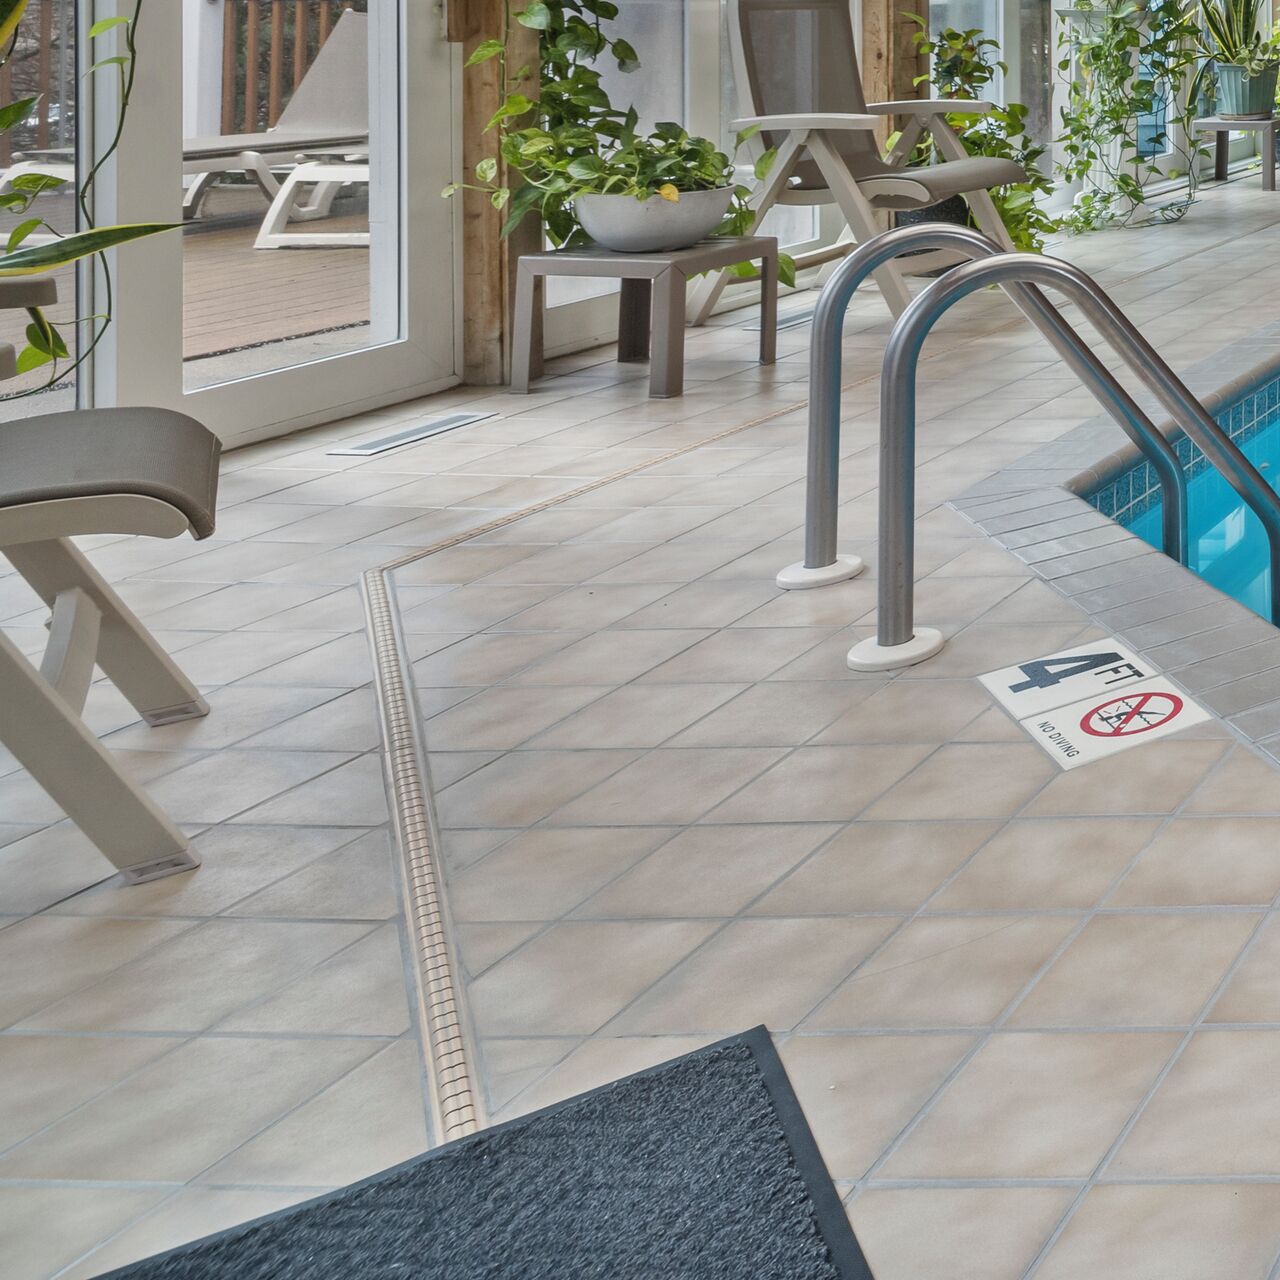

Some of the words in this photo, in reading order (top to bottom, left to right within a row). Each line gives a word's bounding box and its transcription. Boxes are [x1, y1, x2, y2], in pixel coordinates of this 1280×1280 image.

[1007, 651, 1126, 694] 4
[1093, 662, 1145, 685] FT
[1037, 720, 1056, 733] NO
[1048, 732, 1081, 758] DIVING
